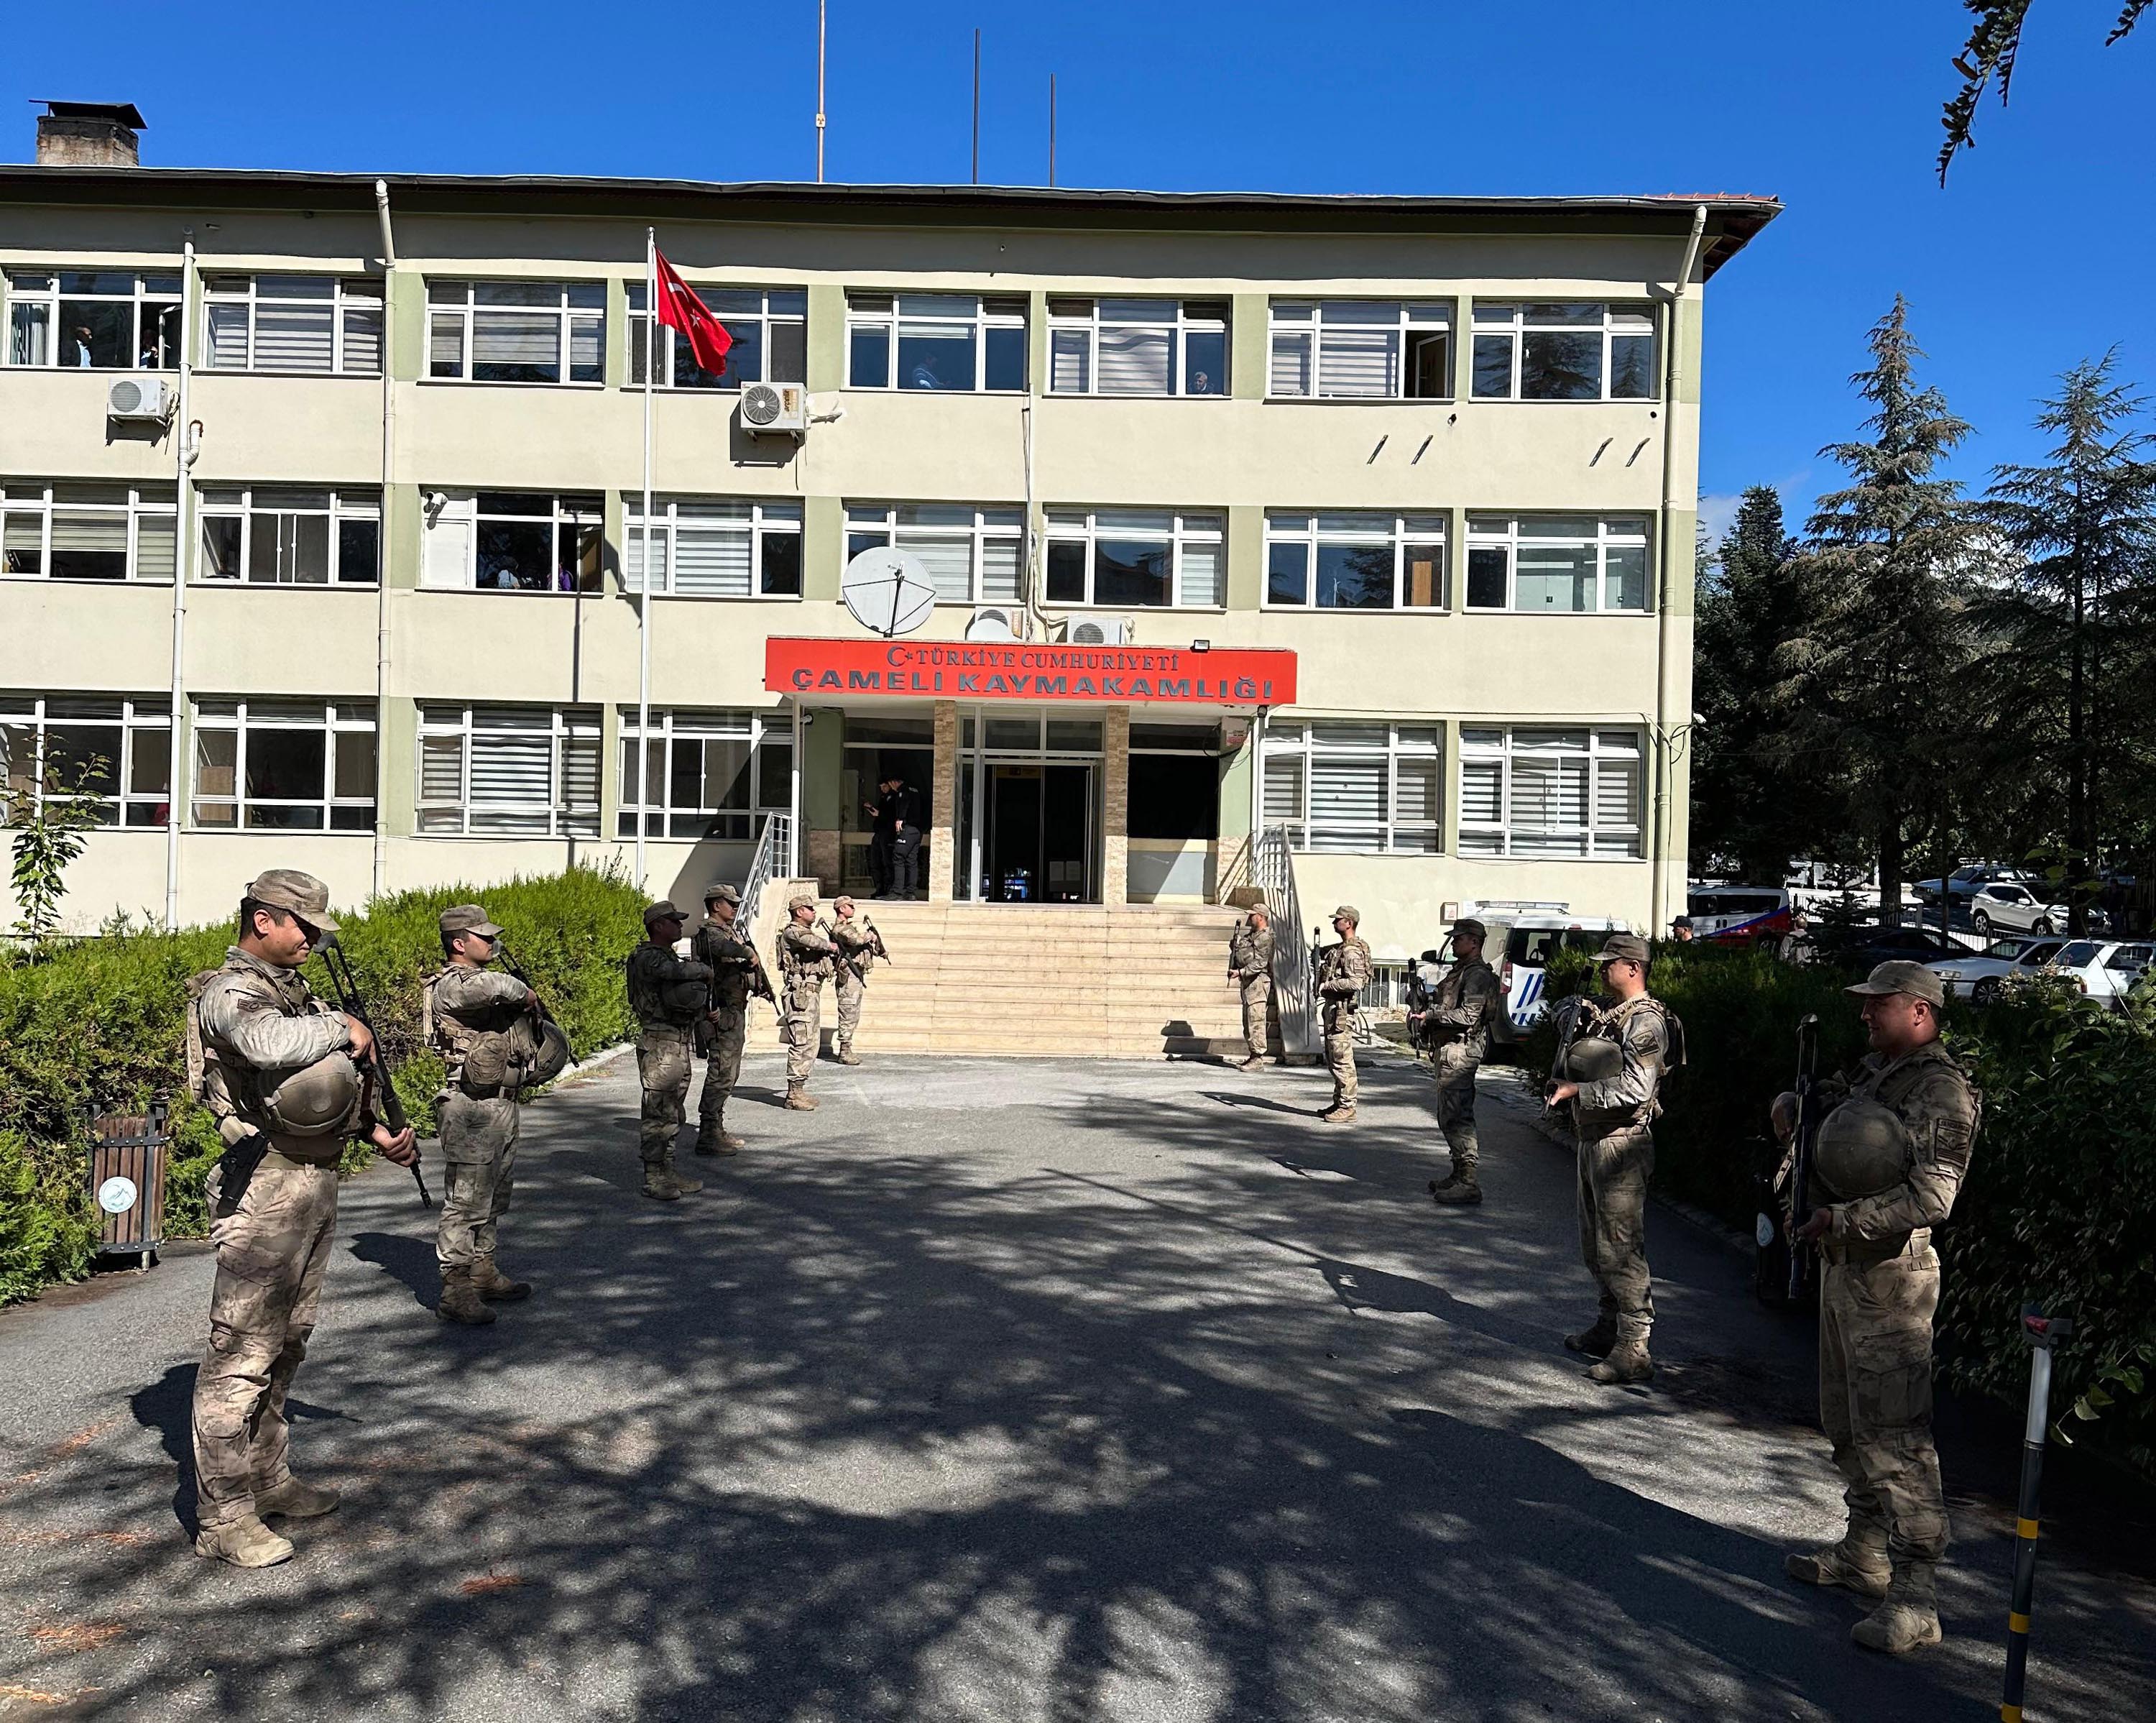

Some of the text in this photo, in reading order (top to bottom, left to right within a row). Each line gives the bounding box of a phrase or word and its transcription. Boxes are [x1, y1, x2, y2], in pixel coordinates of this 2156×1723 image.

[916, 647, 1179, 671] TÜRKİYE CUMHURİYETİ
[792, 668, 1272, 698] ÇAMELİ KAYMAKAMLIĞI
